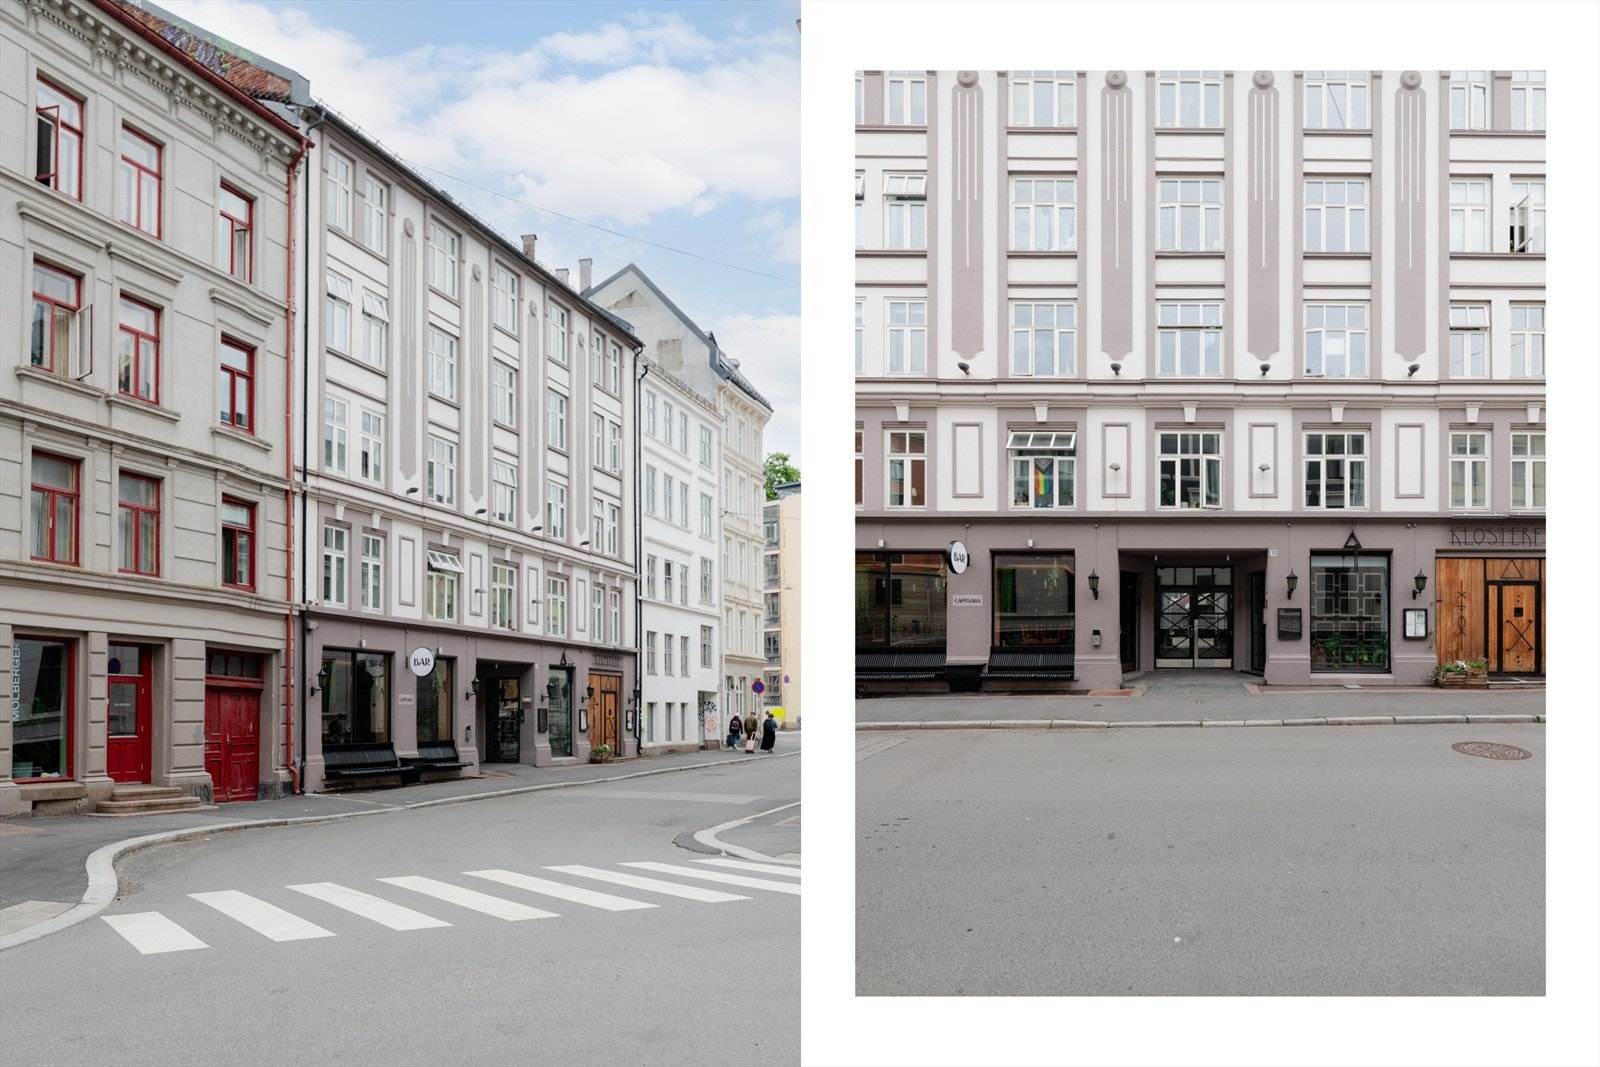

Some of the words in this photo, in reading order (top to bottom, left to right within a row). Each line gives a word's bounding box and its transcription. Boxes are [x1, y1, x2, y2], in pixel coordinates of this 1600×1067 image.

[1449, 527, 1546, 546] KLOSTERE
[953, 552, 966, 563] BAR
[413, 657, 431, 667] BAR
